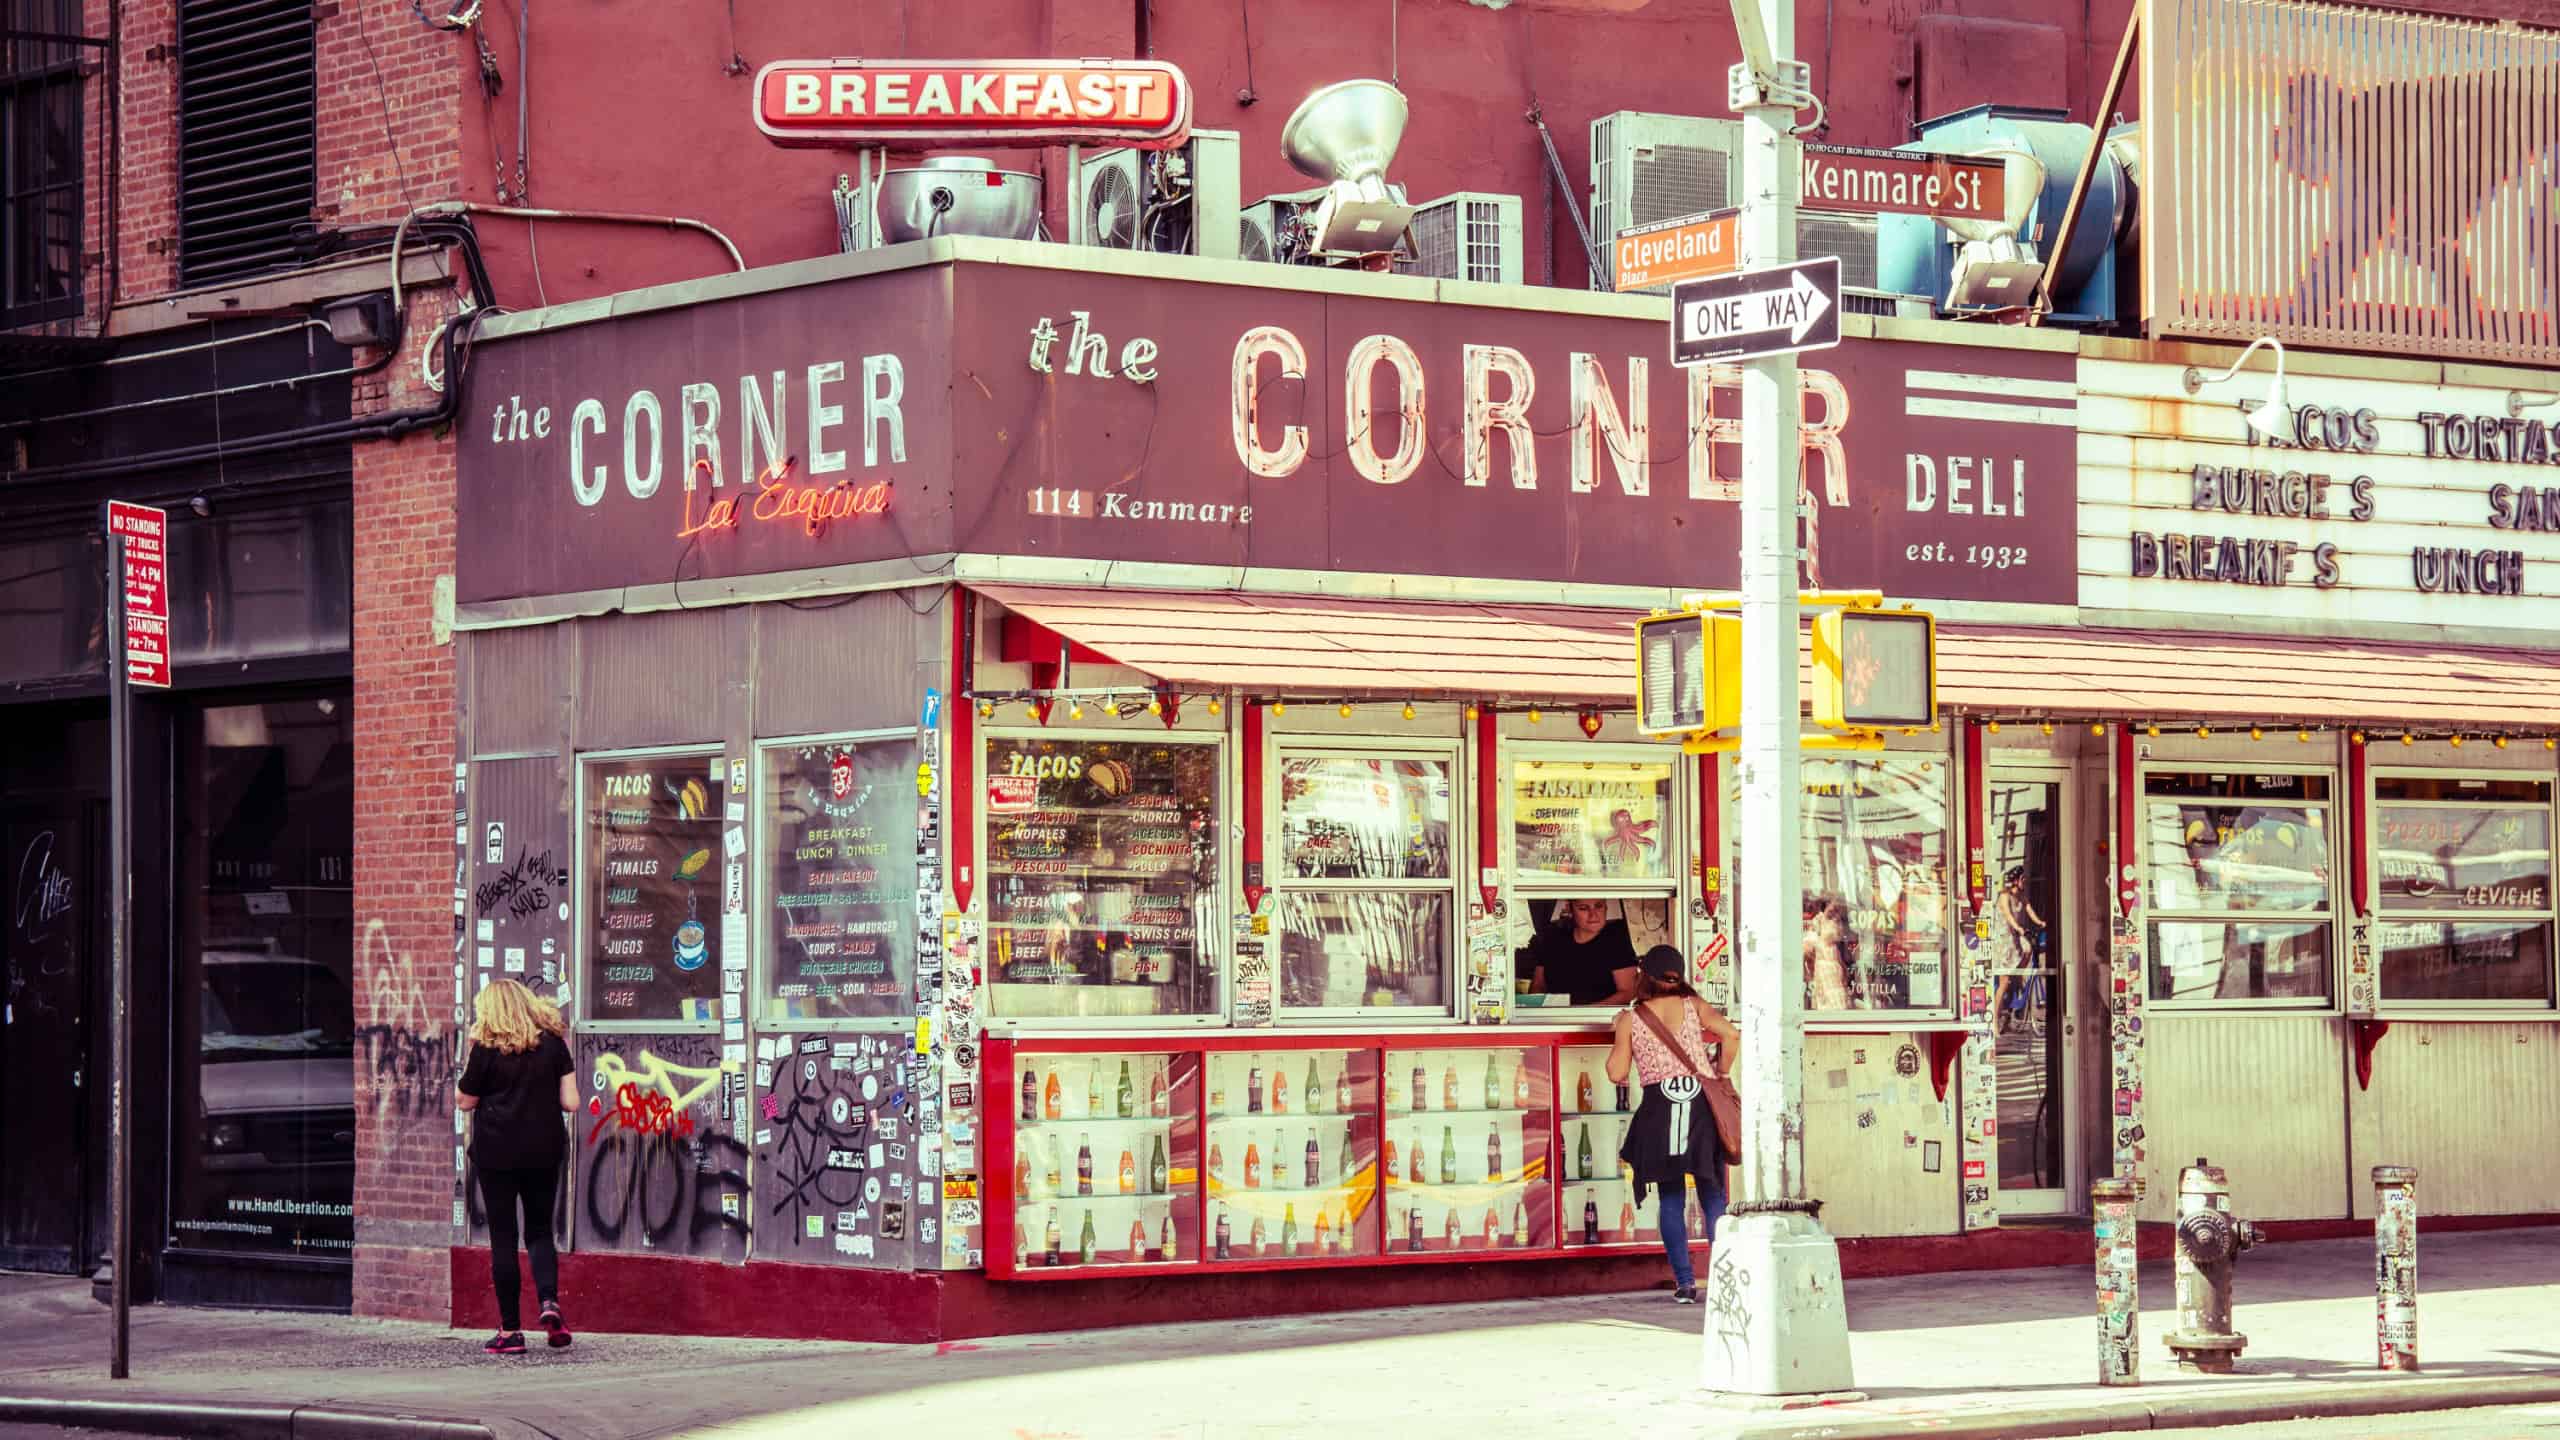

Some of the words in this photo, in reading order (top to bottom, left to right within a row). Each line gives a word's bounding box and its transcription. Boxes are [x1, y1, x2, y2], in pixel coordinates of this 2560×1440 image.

[785, 74, 1155, 118] BREAKFAST
[1896, 151, 1927, 161] DISTRICT
[1804, 159, 1941, 208] Kenmare
[1953, 170, 1982, 211] St
[1621, 224, 1720, 270] Cleveland
[1697, 301, 1743, 335] ONE
[1766, 290, 1813, 327] WAY
[1029, 311, 1159, 384] the
[492, 394, 552, 443] the
[570, 352, 907, 507] CORNER
[1231, 325, 1851, 508] CORNER
[2240, 398, 2381, 454] TCOS
[677, 458, 738, 538] La
[1905, 452, 2025, 518] DELI
[1033, 487, 1081, 515] 114
[1102, 492, 1255, 525] Kenmare
[113, 514, 124, 530] NO
[125, 516, 161, 536] STANDING
[137, 537, 160, 551] TRUCKS
[1905, 541, 1955, 564] est.
[1965, 543, 2029, 570] 1932
[141, 565, 147, 580] 4
[148, 567, 161, 582] PM
[2133, 530, 2298, 587] BREAKF
[2413, 545, 2525, 596] UNCH
[127, 617, 164, 636] STANDING
[1009, 753, 1083, 780] TACOS
[605, 773, 652, 797] TACOS
[808, 826, 873, 842] BREAKFAST
[796, 847, 833, 861] LUNCH
[846, 843, 889, 857] DINNER
[2466, 885, 2544, 906] CEVICHE
[1849, 909, 1896, 930] SOPAS
[808, 942, 836, 956] SOUPS
[843, 983, 865, 995] SODA
[1667, 1074, 1694, 1092] 40
